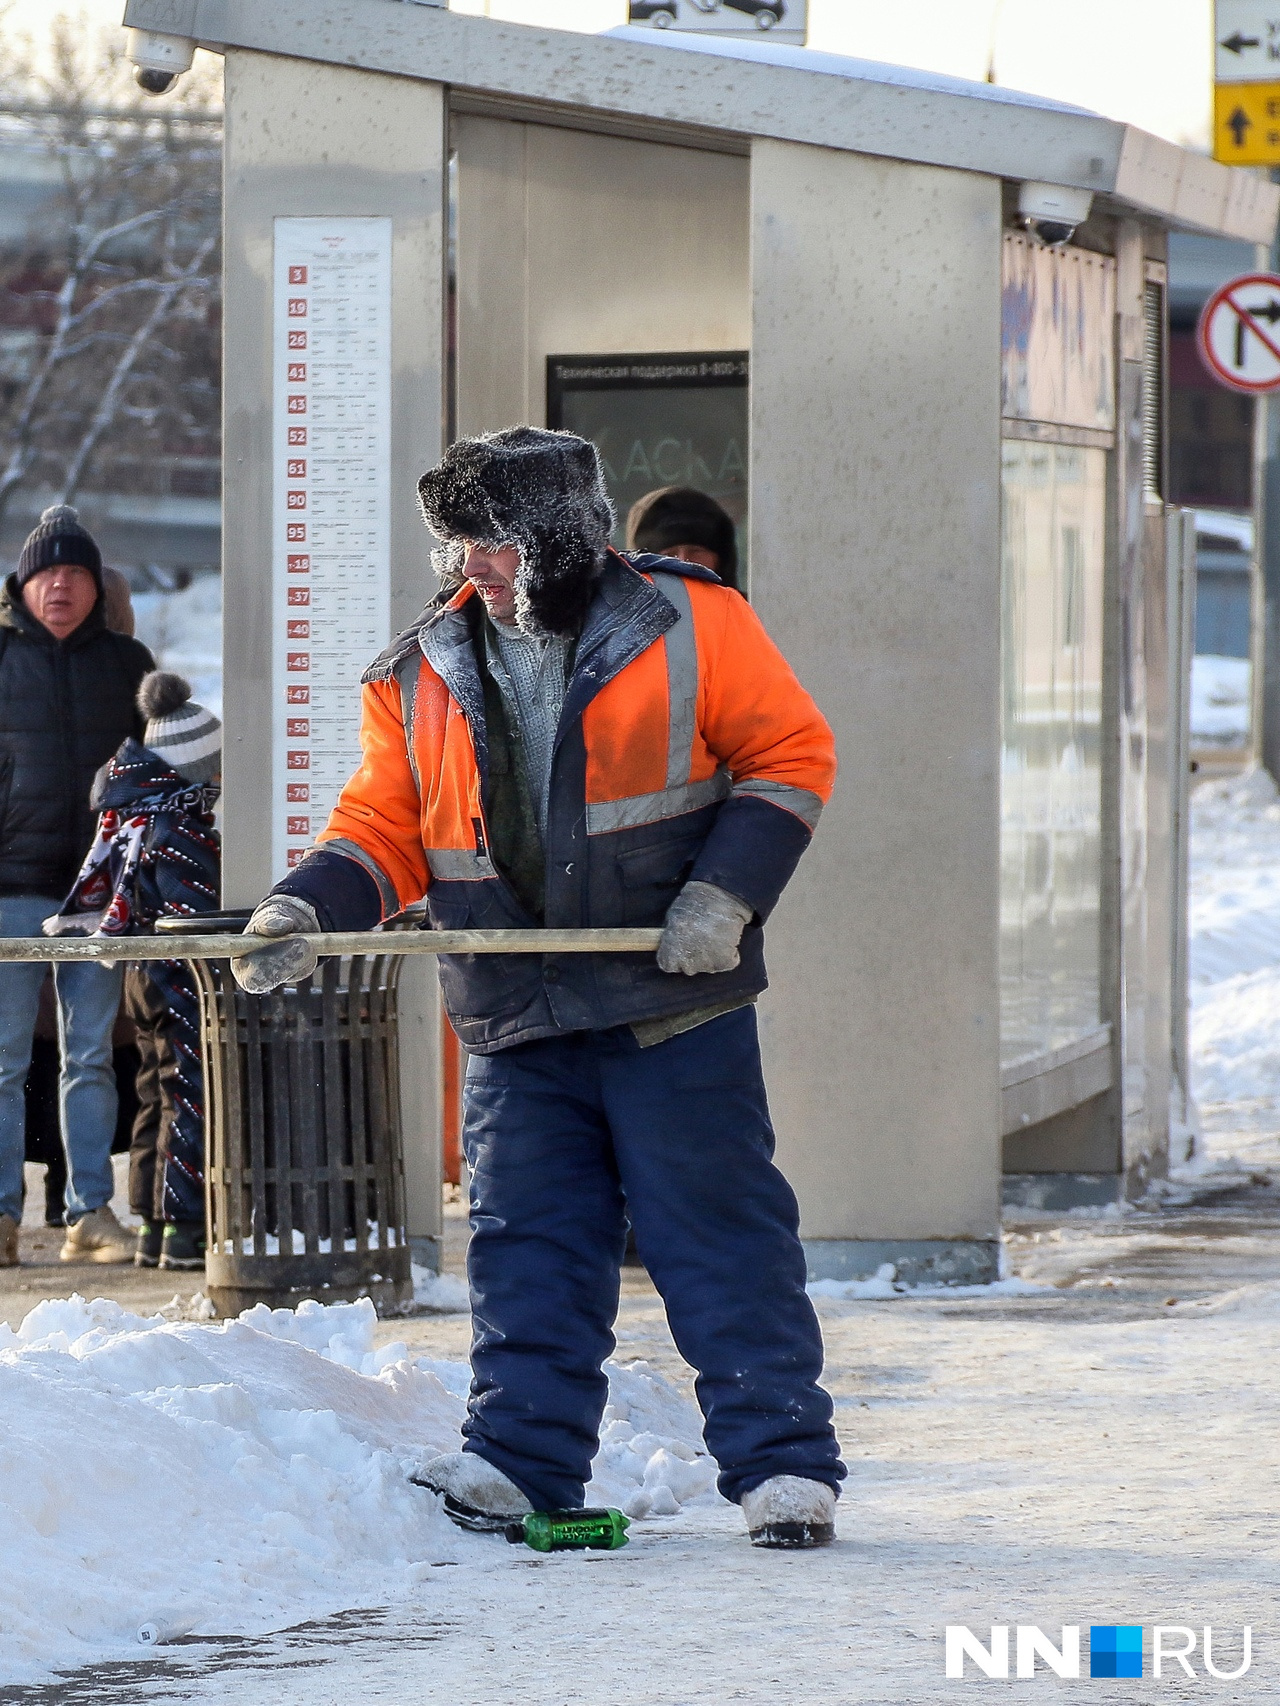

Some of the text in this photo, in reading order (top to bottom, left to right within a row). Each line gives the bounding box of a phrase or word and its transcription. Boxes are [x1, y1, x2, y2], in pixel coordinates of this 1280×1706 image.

[293, 269, 302, 280] 3
[289, 302, 306, 314] 19
[289, 367, 306, 379] 41
[555, 365, 629, 379] Техническая
[631, 364, 697, 380] поддержка
[289, 399, 306, 410] 43
[289, 430, 306, 442] 52
[289, 463, 306, 474] 61
[288, 495, 305, 506] 90
[288, 527, 305, 538] 95
